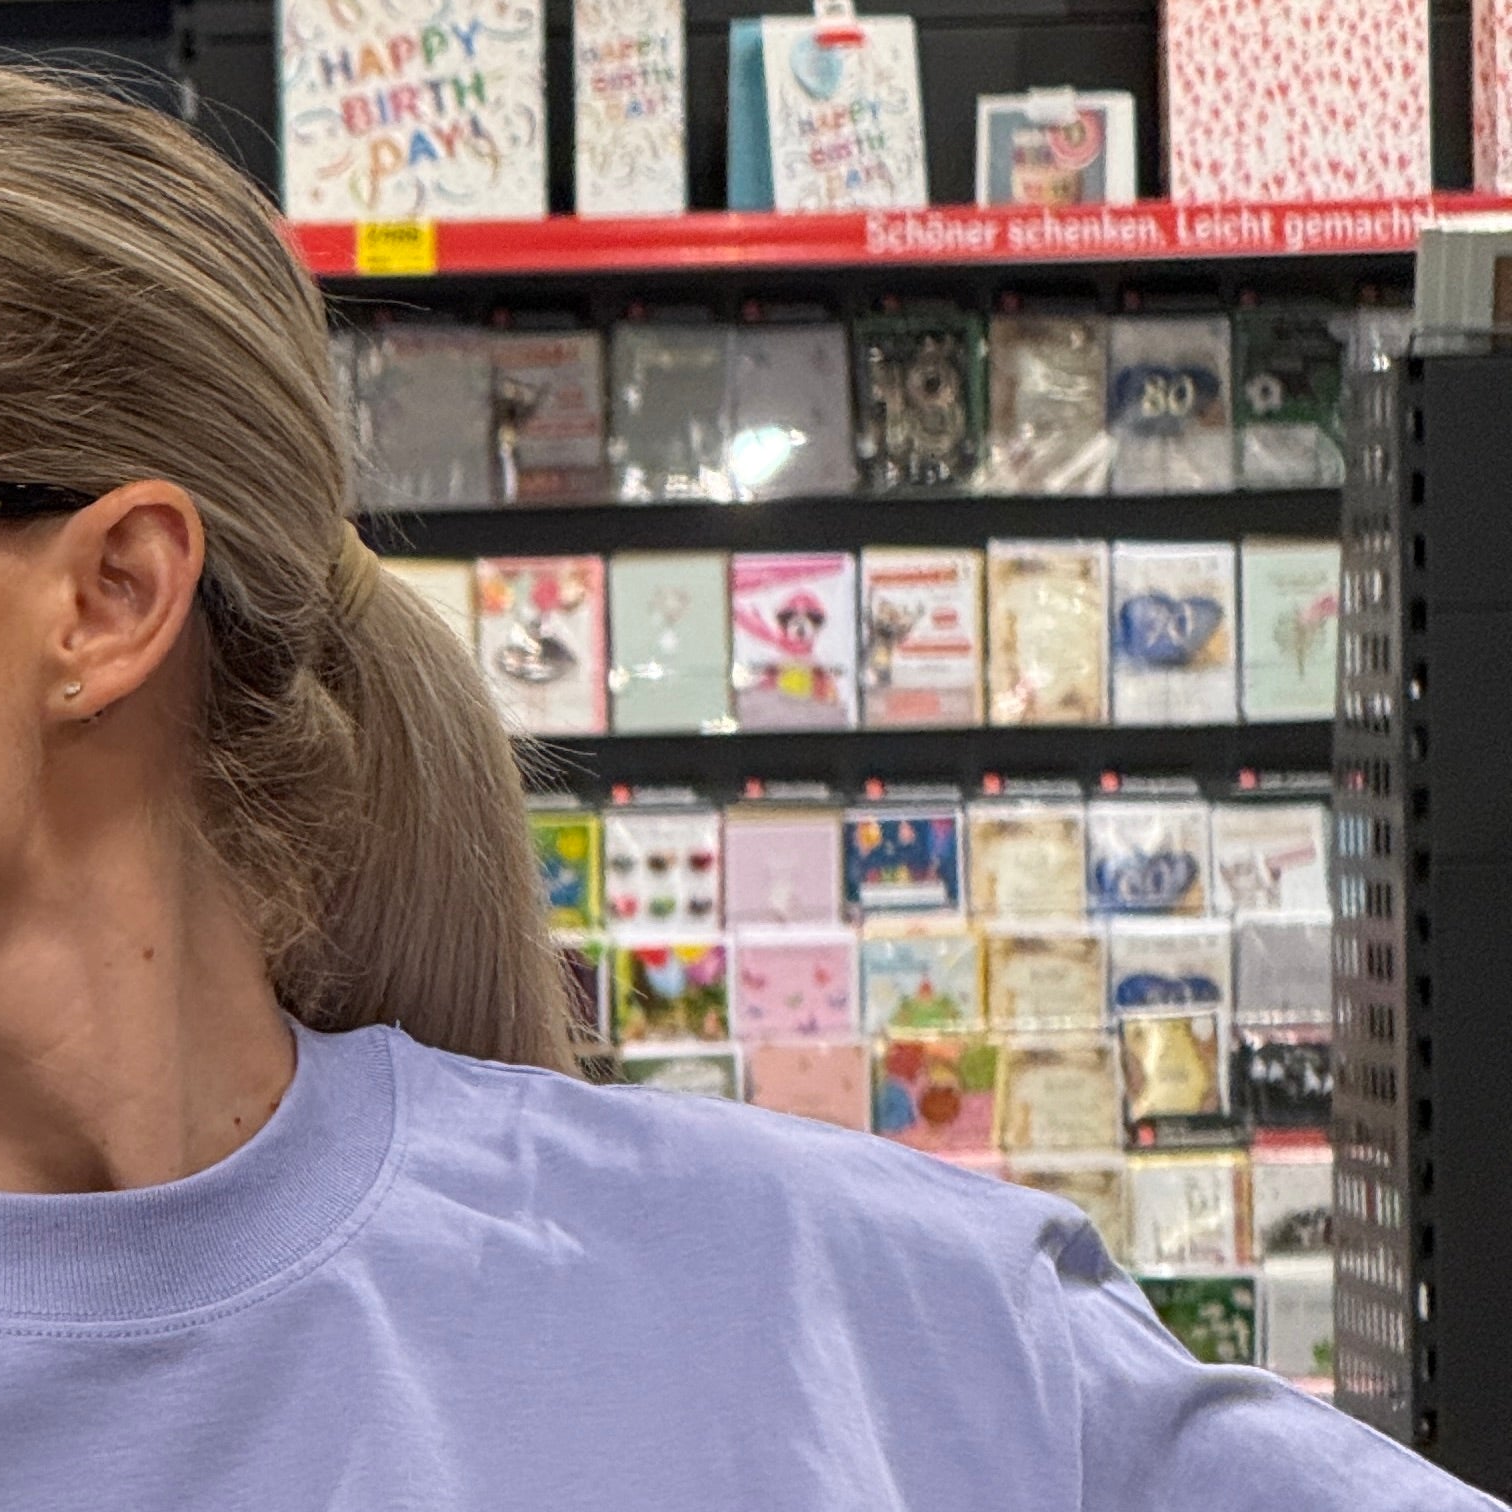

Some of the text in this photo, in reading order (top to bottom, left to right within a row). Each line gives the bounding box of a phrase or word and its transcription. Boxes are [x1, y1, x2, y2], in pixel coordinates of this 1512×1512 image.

[319, 20, 481, 88] HAPPY
[342, 70, 486, 138] BIRTH
[1176, 201, 1274, 244] Leicht
[1141, 374, 1195, 418] 80
